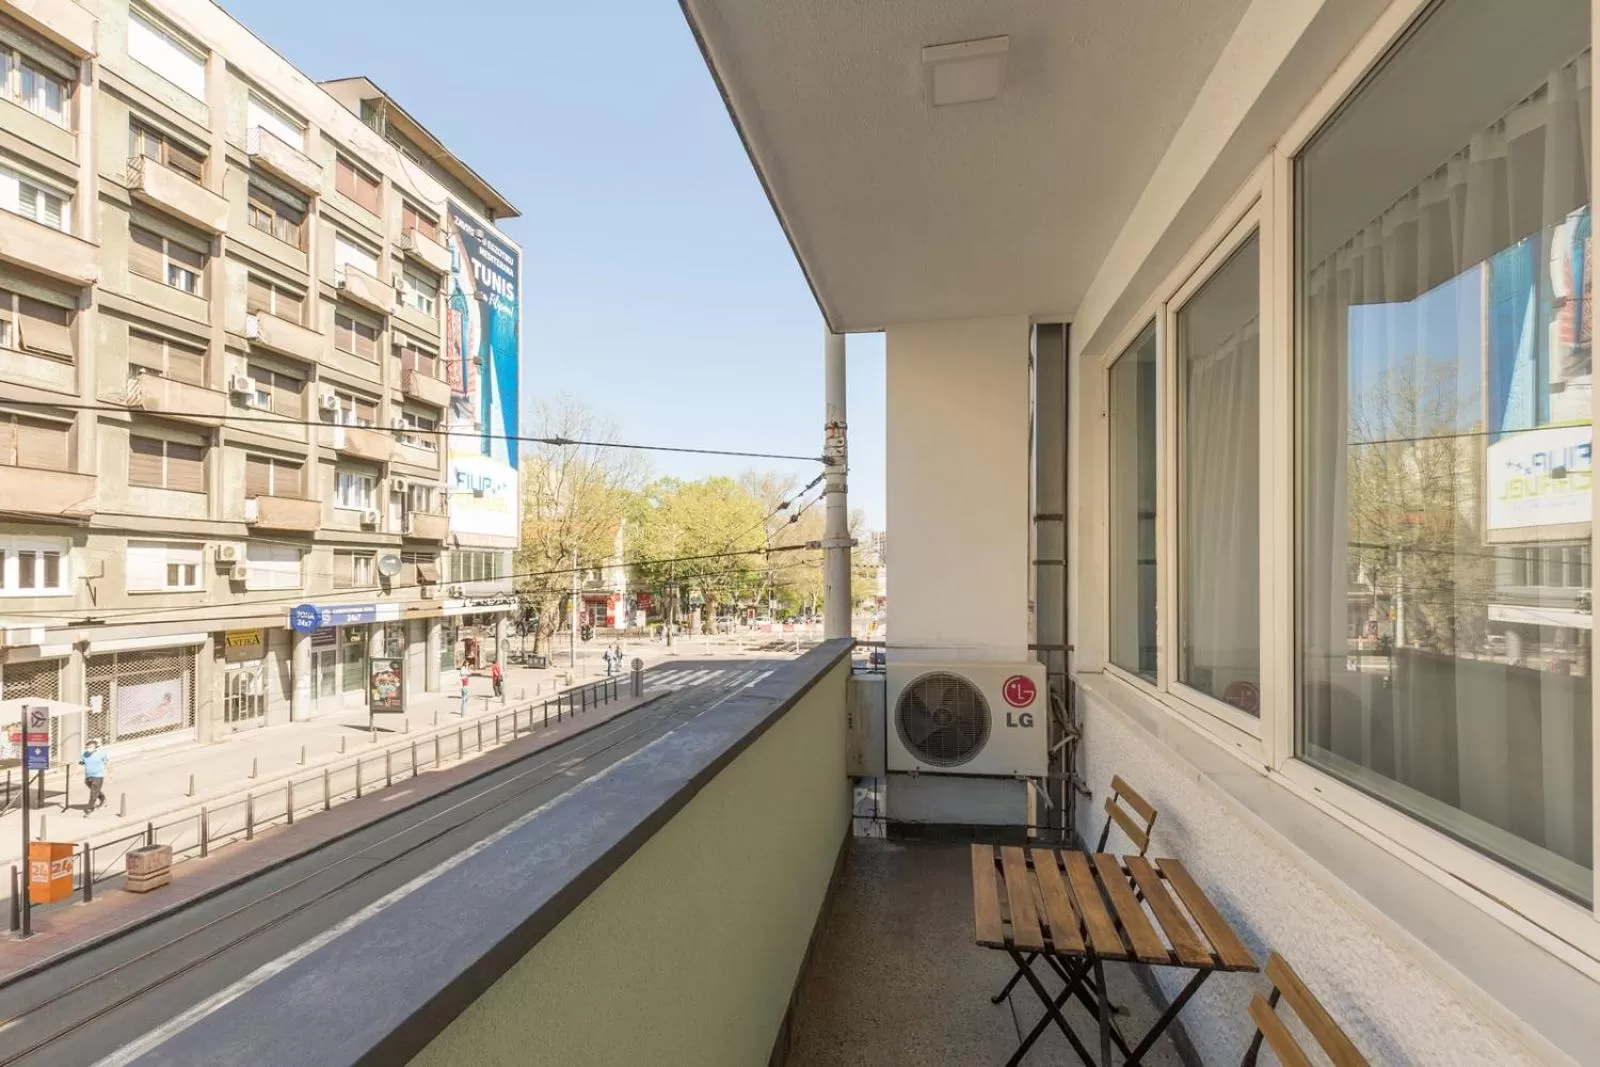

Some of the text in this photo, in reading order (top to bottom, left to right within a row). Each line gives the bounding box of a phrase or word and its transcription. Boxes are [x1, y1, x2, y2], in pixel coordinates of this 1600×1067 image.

[471, 257, 514, 301] TUNIS
[456, 472, 493, 492] FILIP
[1006, 712, 1034, 728] LG
